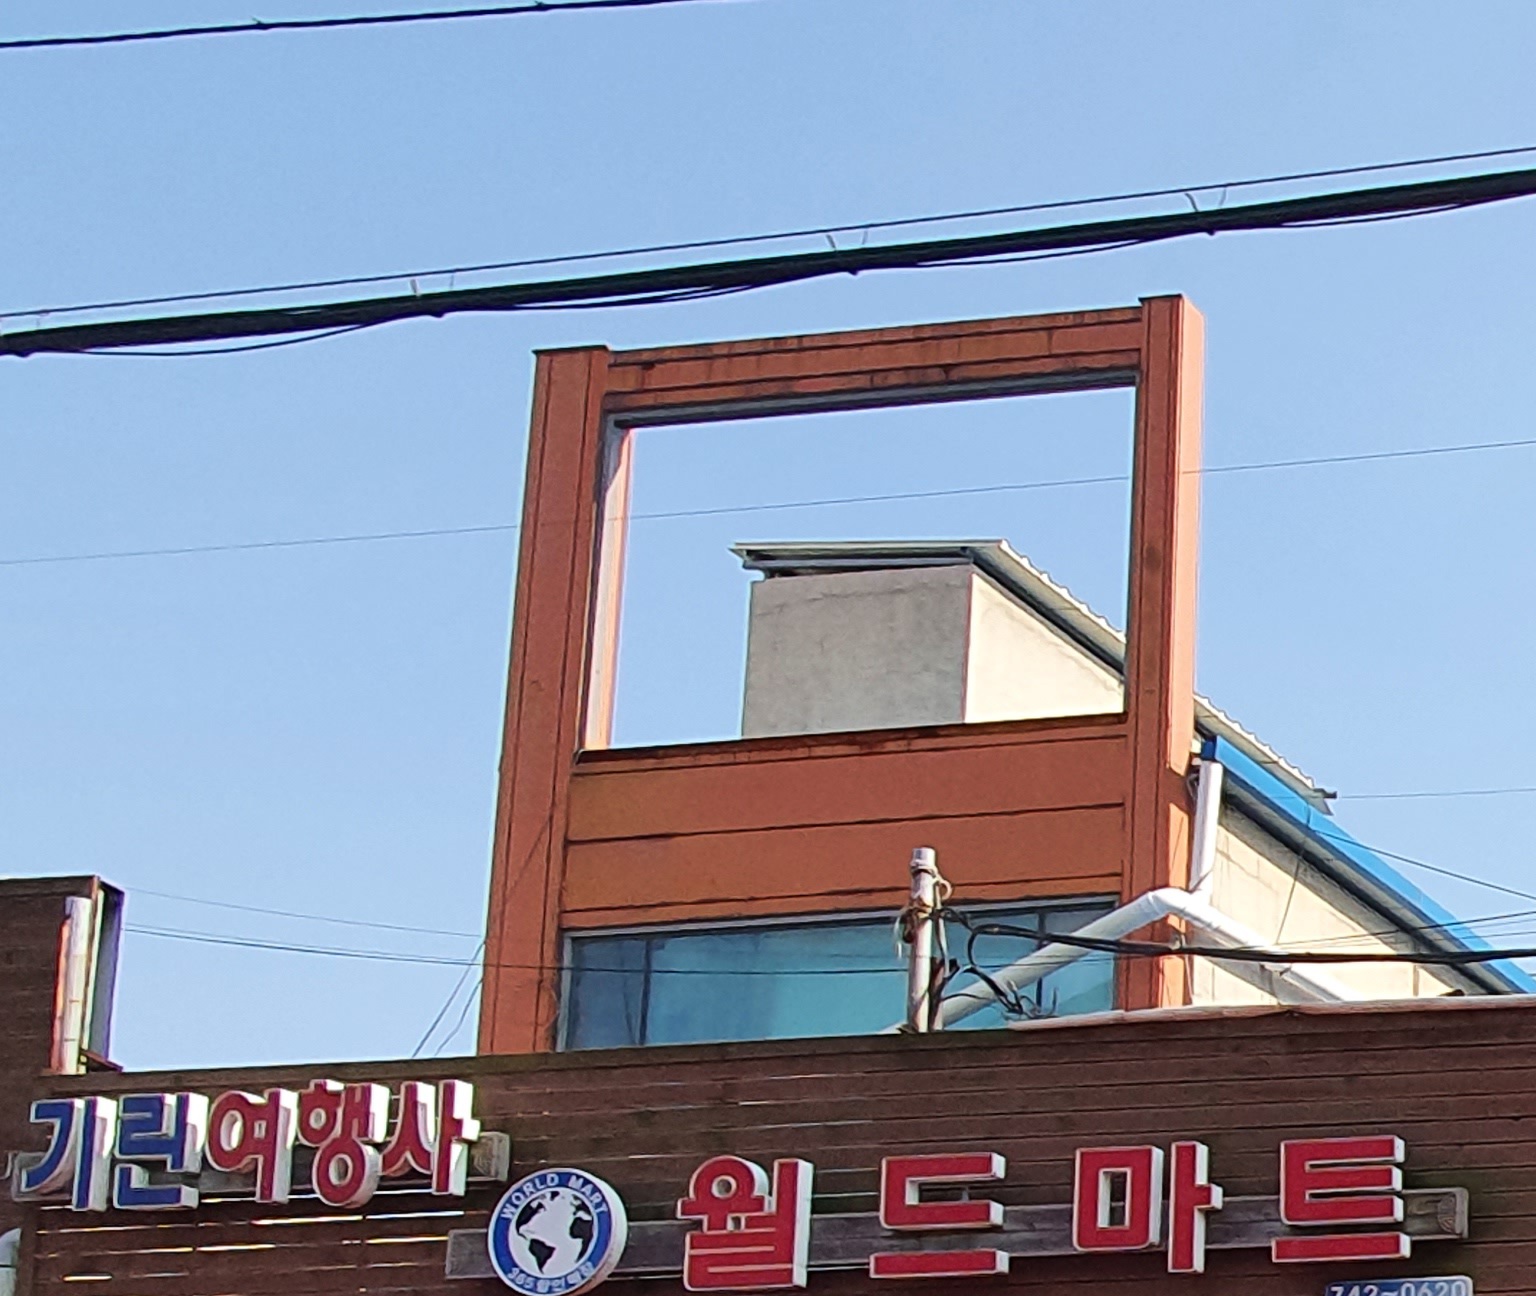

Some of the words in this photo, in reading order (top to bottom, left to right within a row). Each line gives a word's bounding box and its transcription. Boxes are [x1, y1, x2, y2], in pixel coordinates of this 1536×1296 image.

[20, 1078, 481, 1212] 기린여행사
[500, 1173, 560, 1220] WORLD
[567, 1174, 608, 1214] MART
[676, 1134, 1413, 1292] 월드마트
